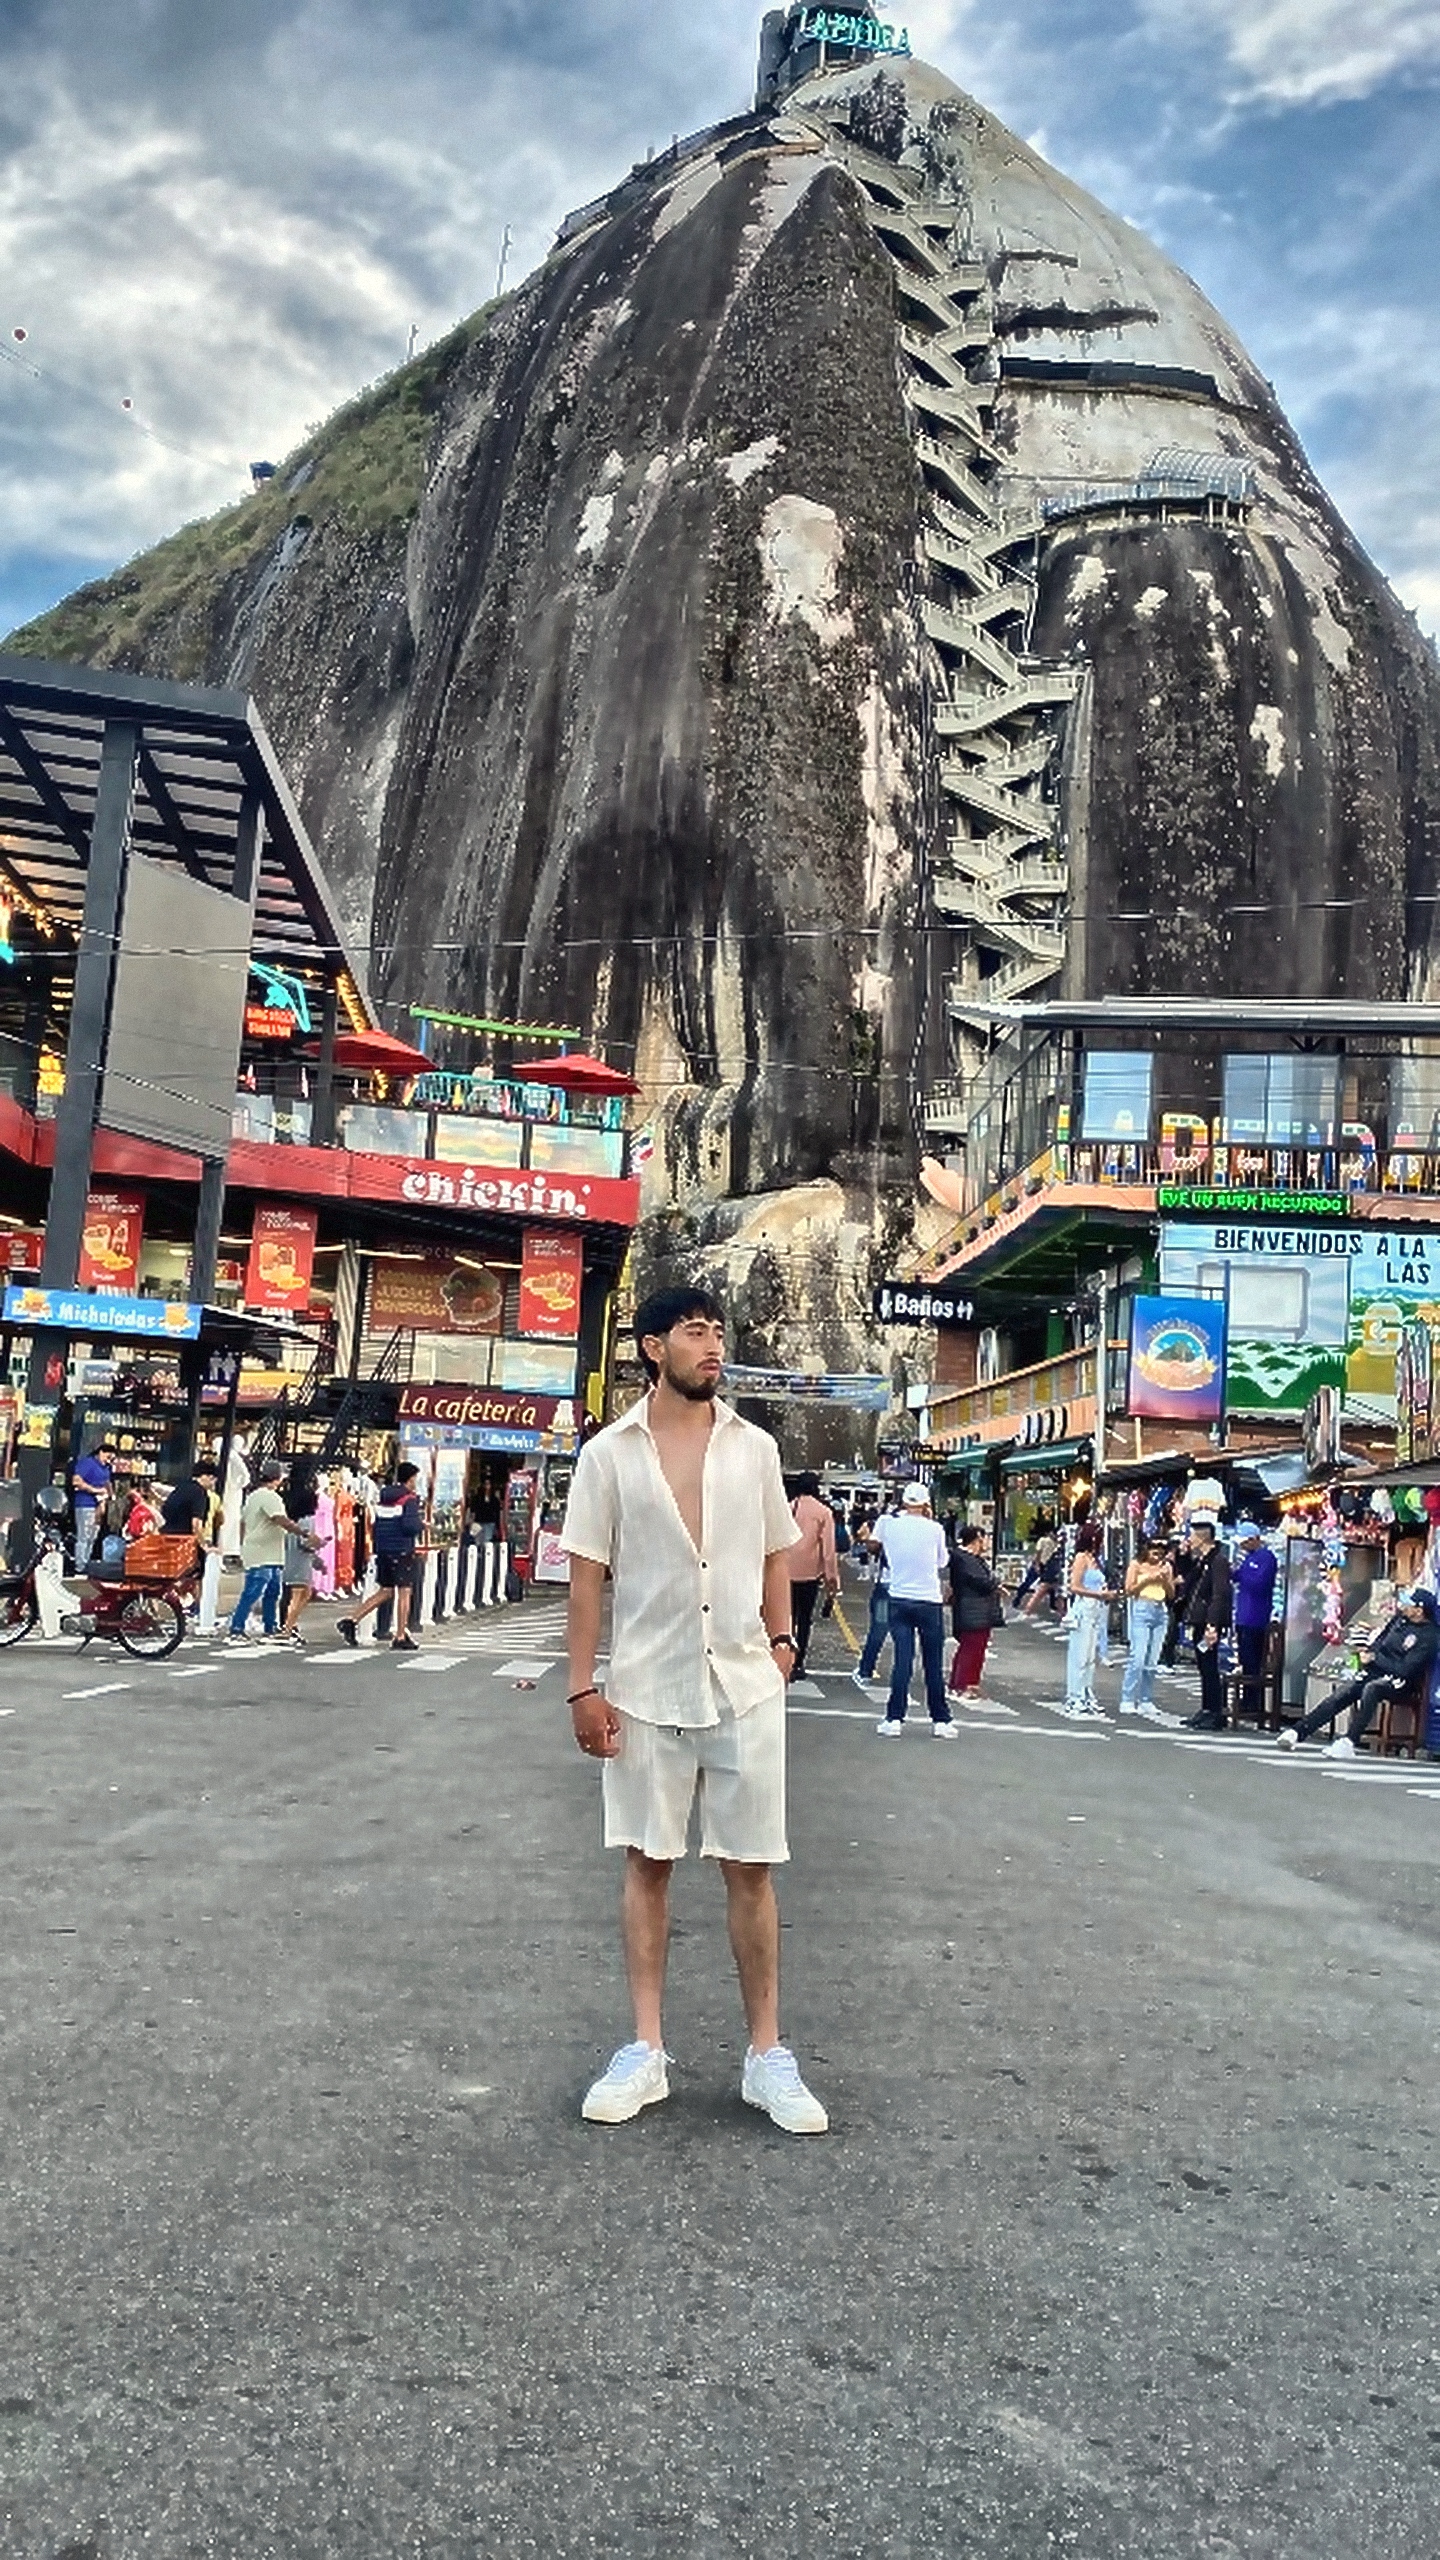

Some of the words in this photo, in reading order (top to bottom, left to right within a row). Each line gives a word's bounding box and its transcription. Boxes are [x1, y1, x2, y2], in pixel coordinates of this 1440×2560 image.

[1214, 1229, 1363, 1255] BIENVENIDOS
[1376, 1236, 1389, 1256] A
[1399, 1237, 1426, 1258] LA
[1387, 1262, 1431, 1285] LAS
[895, 1290, 954, 1318] Baños
[399, 1389, 426, 1416] La
[433, 1394, 536, 1426] cafetería
